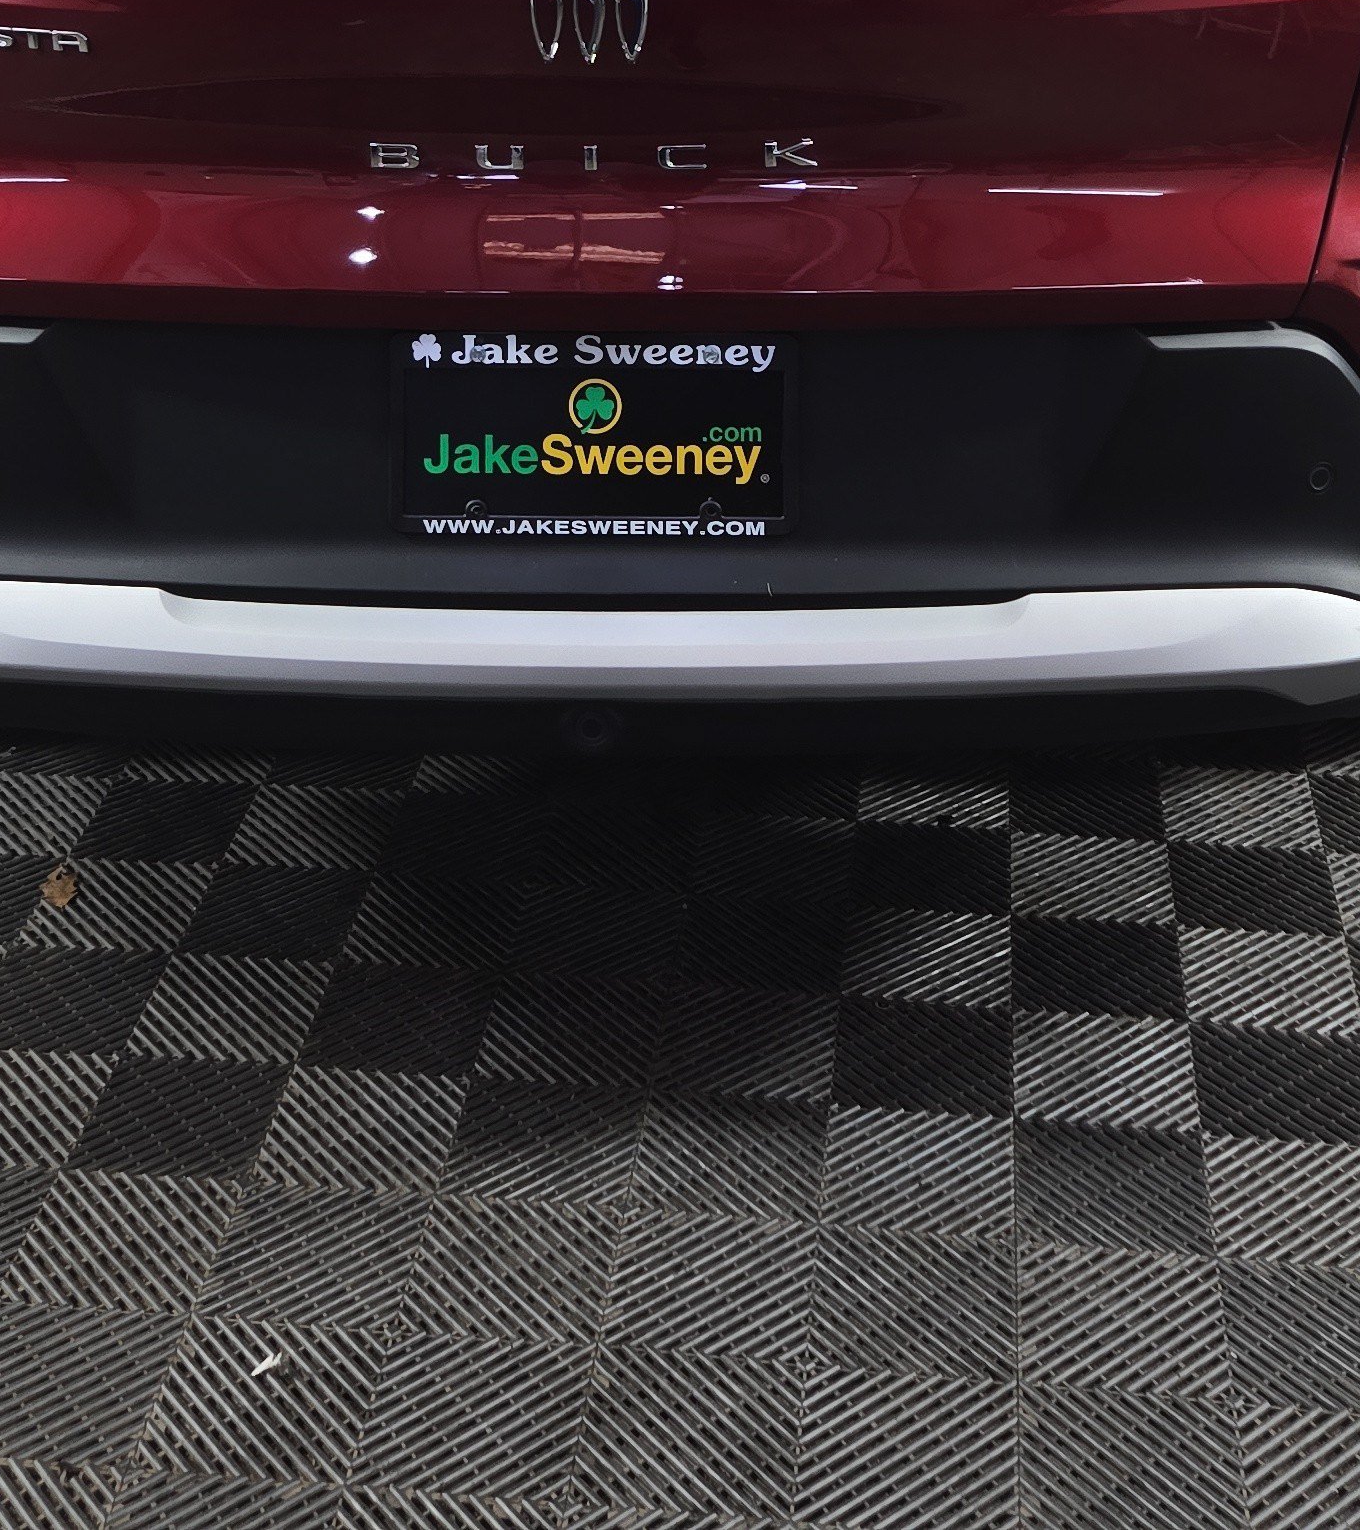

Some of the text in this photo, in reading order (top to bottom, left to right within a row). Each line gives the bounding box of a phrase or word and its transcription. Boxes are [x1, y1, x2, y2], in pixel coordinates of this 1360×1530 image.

[369, 138, 819, 171] BUICK
[451, 334, 776, 373] Jake Sweeney
[423, 425, 762, 485] JakeSweeney .com
[423, 519, 766, 536] WWW.JAKESWEENEY.COM
